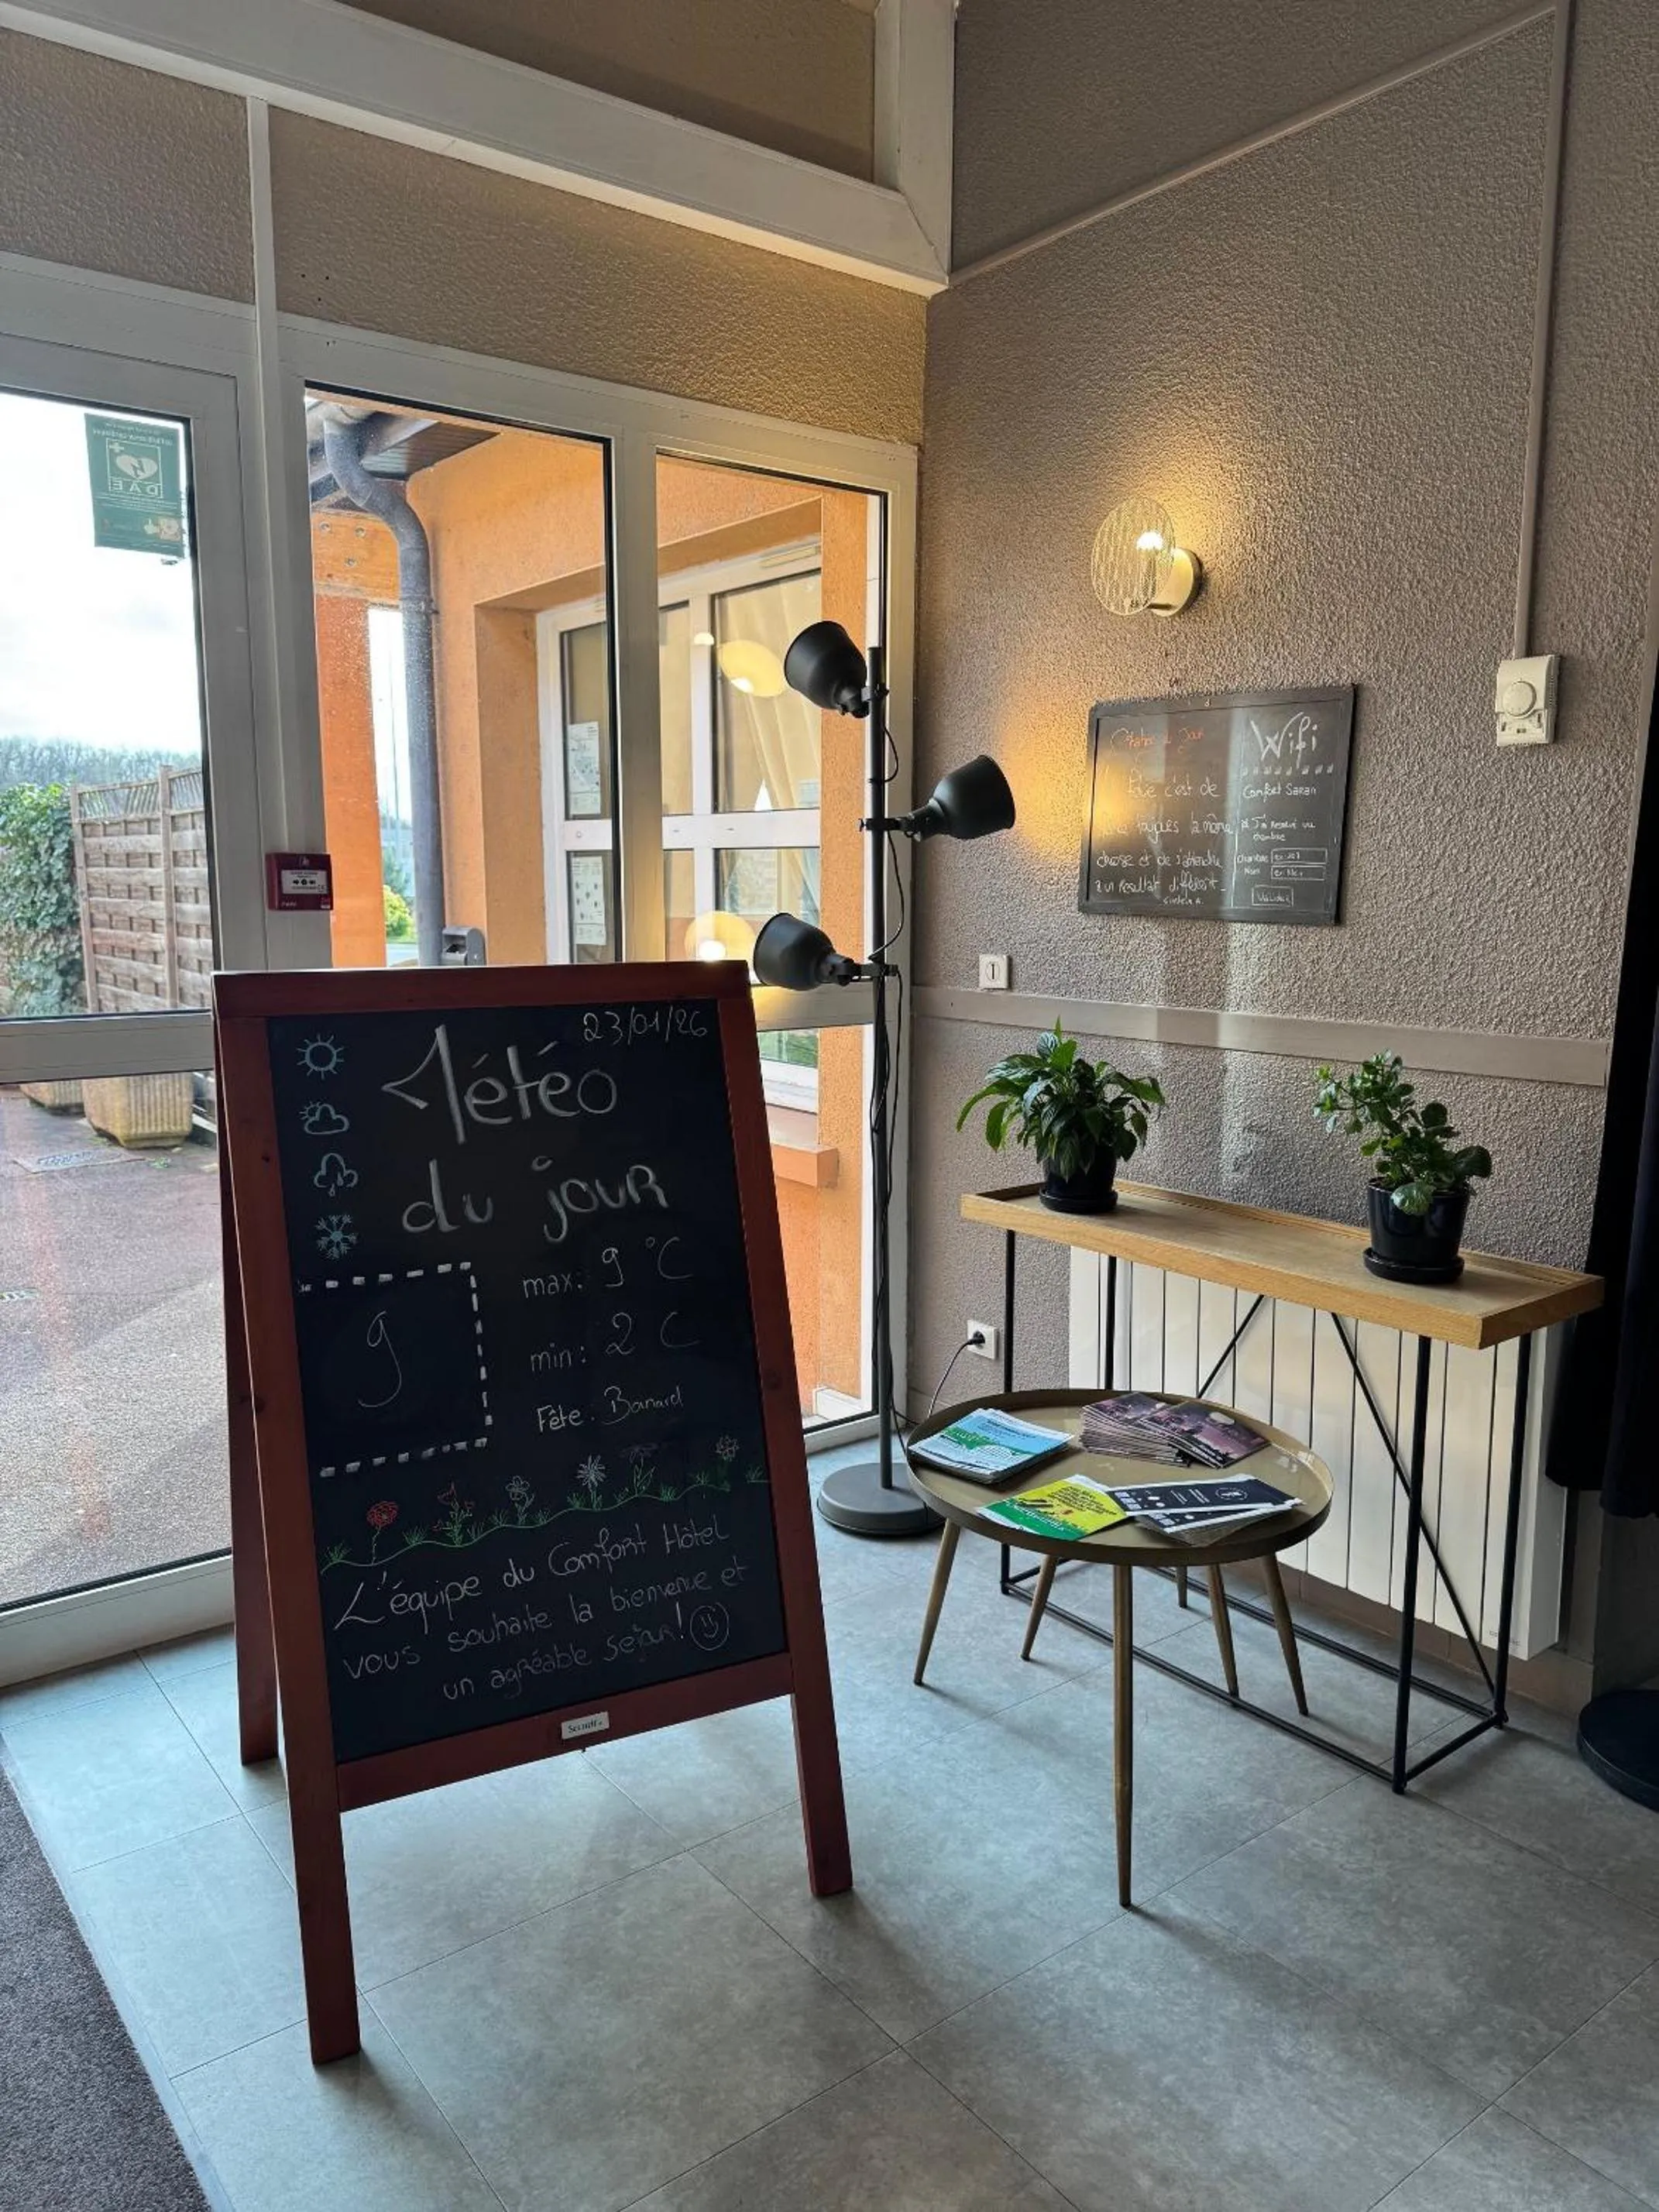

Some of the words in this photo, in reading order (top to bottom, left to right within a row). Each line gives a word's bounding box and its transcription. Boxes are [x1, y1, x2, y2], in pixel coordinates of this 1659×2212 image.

[1249, 712, 1318, 769] Wifi
[1200, 777, 1221, 797] de
[582, 1007, 708, 1046] 23/01/26
[382, 1024, 618, 1145] Météo
[401, 1158, 495, 1233] du
[606, 1311, 636, 1355] 2
[334, 1570, 483, 1635] L'équipe
[503, 1558, 535, 1588] du
[548, 1522, 647, 1575] Comfort
[343, 1645, 421, 1679] vous
[448, 1604, 553, 1652] souhaite
[568, 1592, 594, 1624] la
[610, 1570, 713, 1612] bienvenue
[720, 1554, 748, 1587] et
[443, 1677, 475, 1699] un
[489, 1643, 592, 1699] agréable
